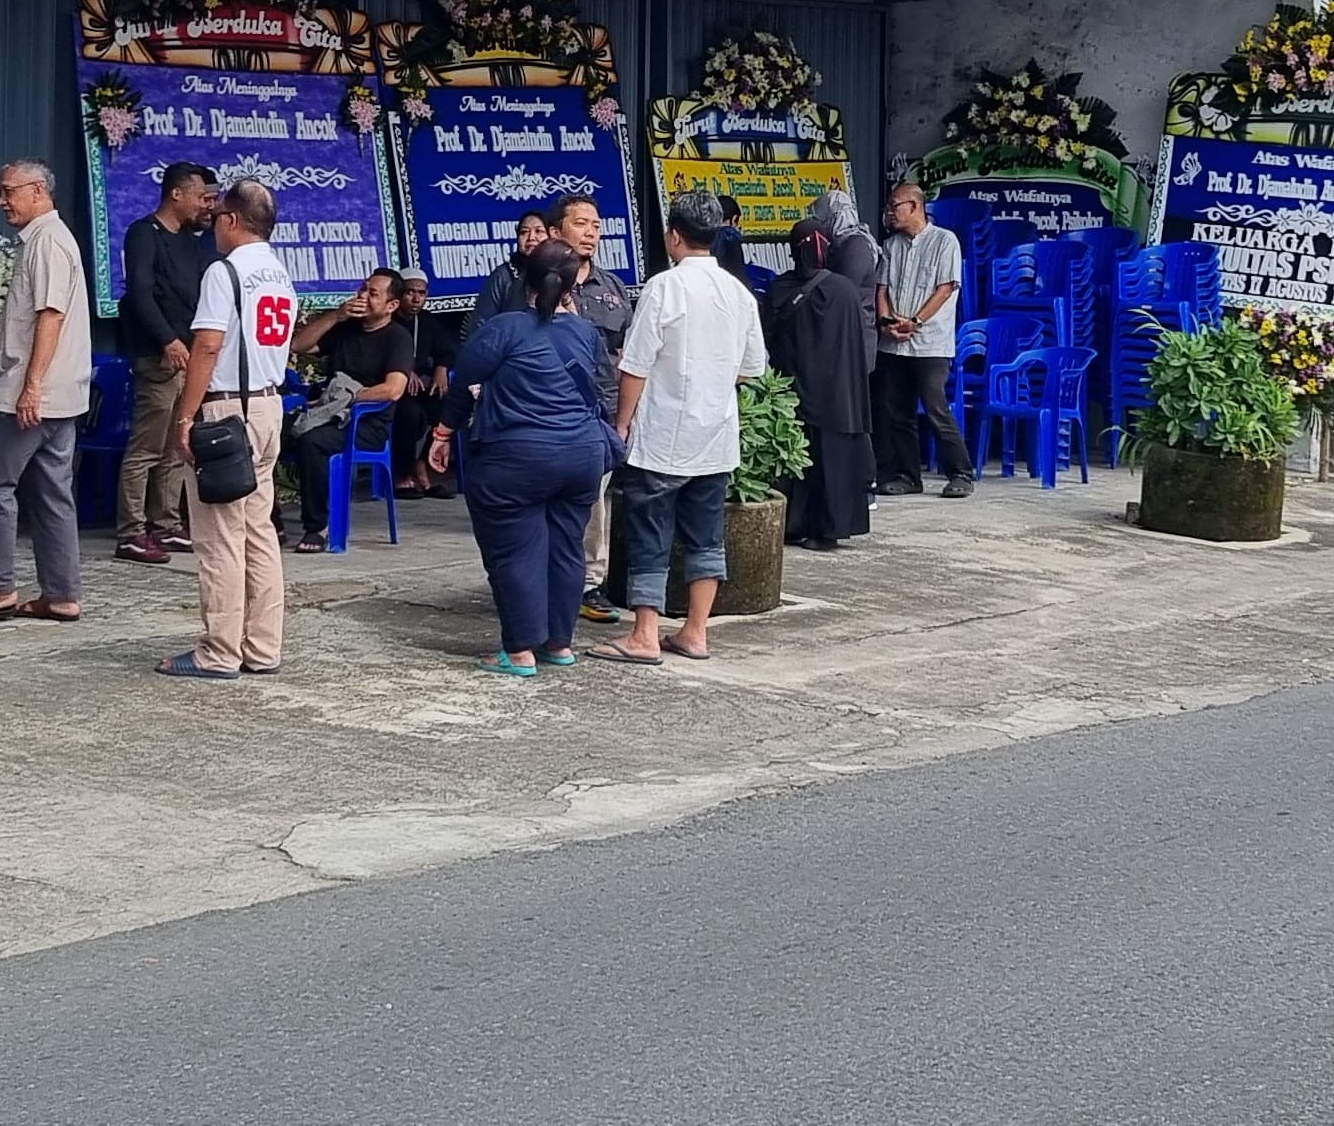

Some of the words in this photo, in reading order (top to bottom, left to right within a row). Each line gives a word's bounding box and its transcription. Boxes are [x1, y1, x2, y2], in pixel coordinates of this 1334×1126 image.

[294, 15, 344, 51] Cita
[181, 75, 214, 94] Atas
[217, 77, 299, 103] Meninggalnya
[143, 106, 179, 137] Prof.
[183, 106, 206, 138] Dr.
[209, 108, 289, 144] Djamaludin
[295, 111, 339, 141] Ancok
[433, 125, 464, 153] Prof.
[468, 125, 488, 153] Dr.
[560, 125, 595, 152] Ancok
[1251, 150, 1290, 167] Atas
[1003, 189, 1072, 206] Wafatnya
[308, 221, 363, 243] DOKTOR
[428, 221, 489, 242] PROGRAM
[1191, 223, 1317, 256] KELUARGA
[322, 245, 380, 282] JAKARTA
[1218, 245, 1295, 279] KULTAS
[1265, 279, 1328, 304] AGUSTUS
[256, 295, 291, 348] 65
